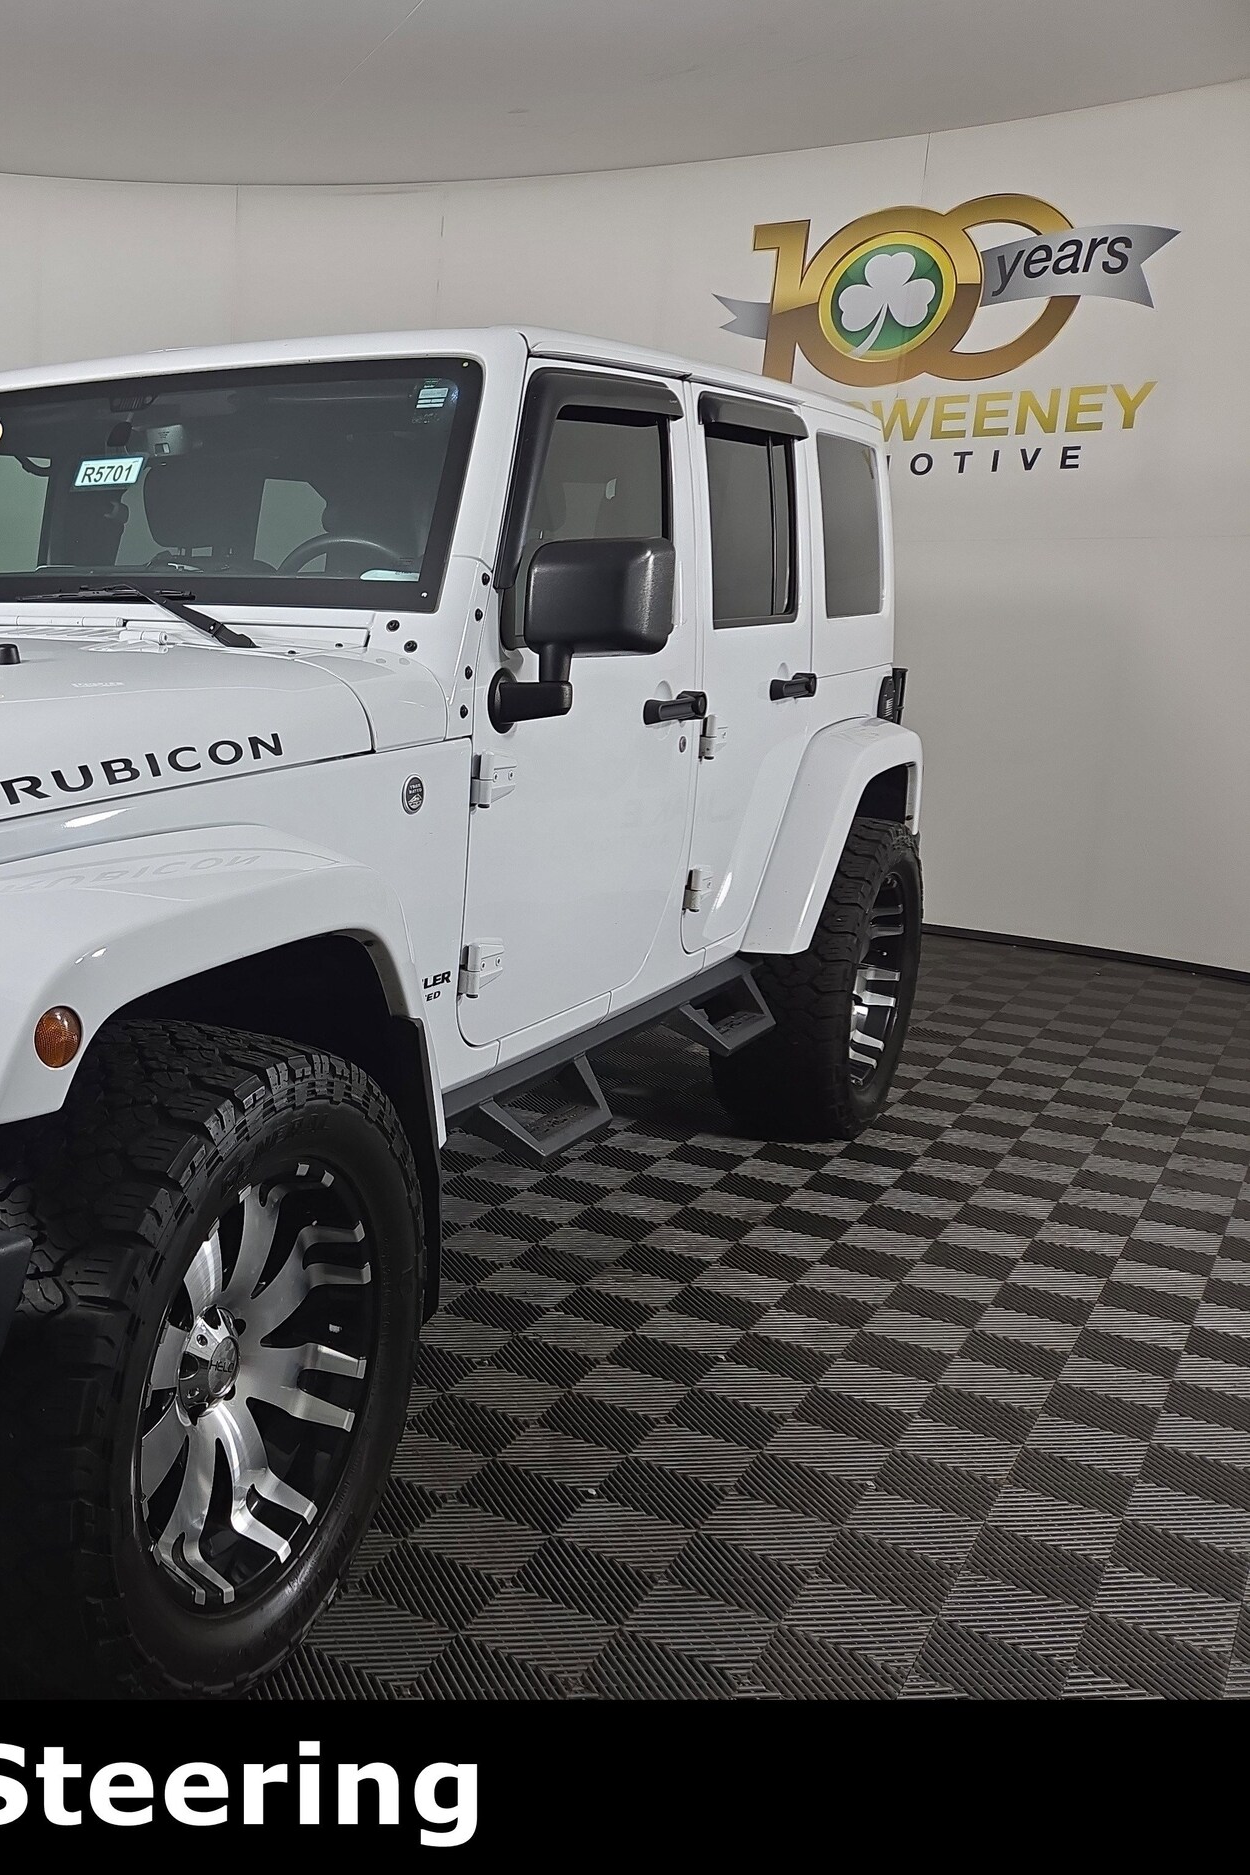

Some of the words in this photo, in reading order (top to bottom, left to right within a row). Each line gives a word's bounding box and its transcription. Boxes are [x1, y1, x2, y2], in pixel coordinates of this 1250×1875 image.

[753, 193, 1081, 387] 100
[992, 234, 1133, 298] years
[847, 380, 1158, 442] WEENEY
[81, 464, 133, 484] R5701
[886, 445, 1082, 476] OTIVE
[0, 732, 285, 805] RUBICON
[422, 970, 451, 990] LER
[425, 990, 441, 1002] ED
